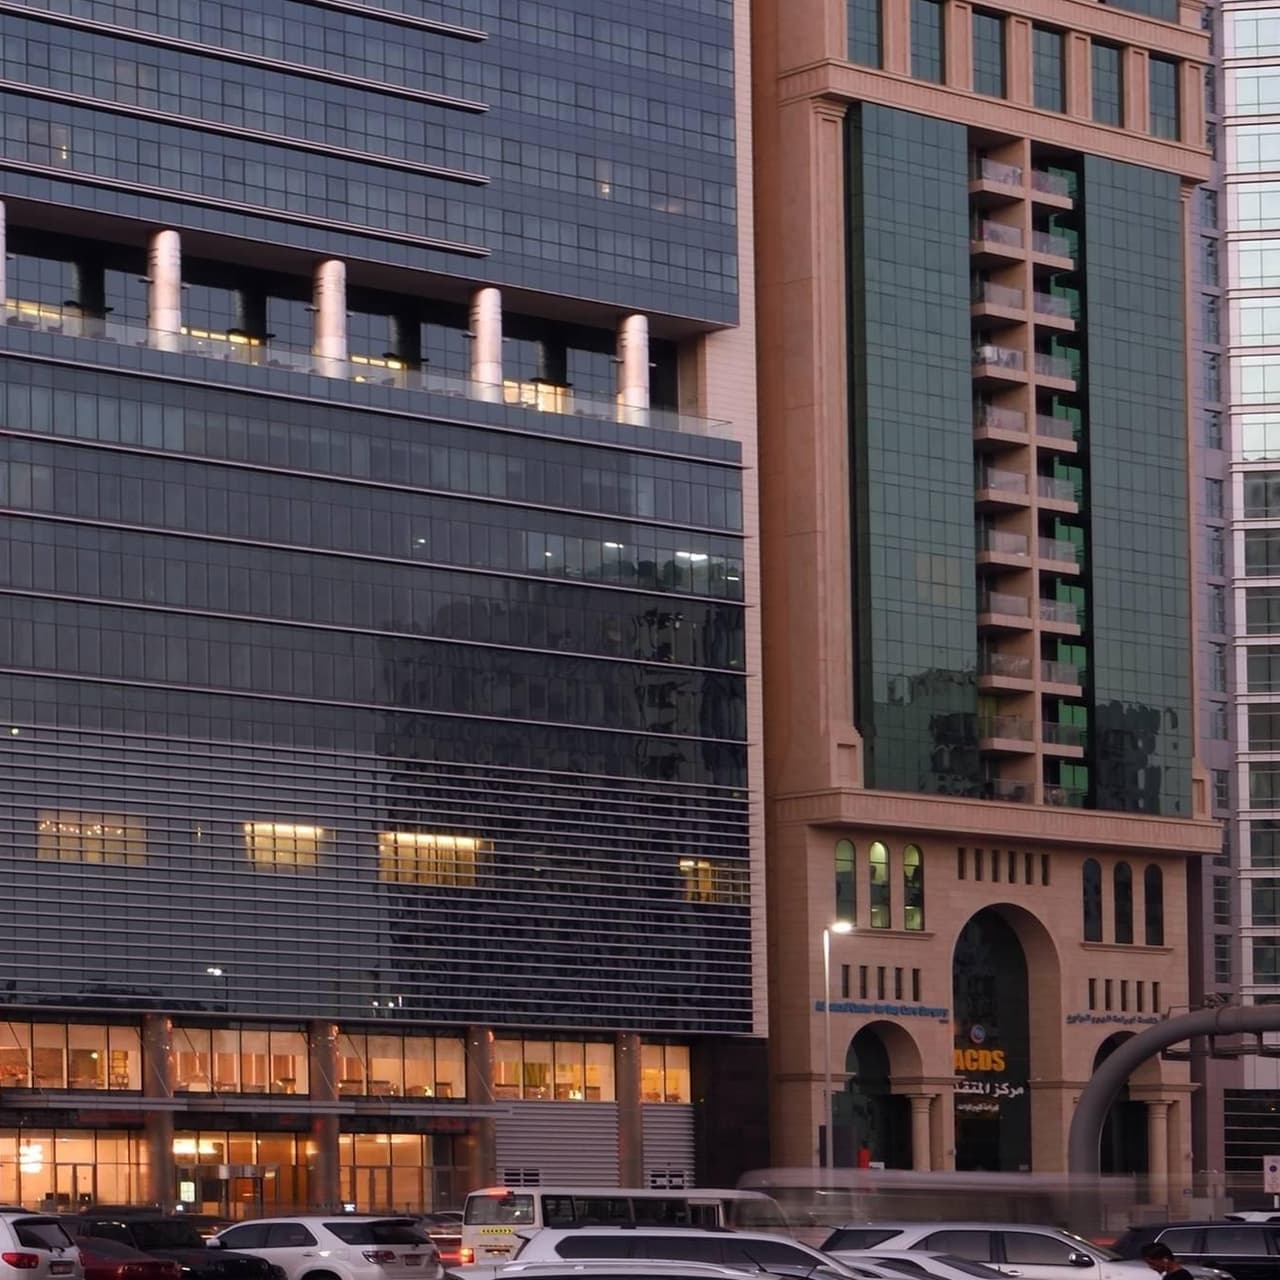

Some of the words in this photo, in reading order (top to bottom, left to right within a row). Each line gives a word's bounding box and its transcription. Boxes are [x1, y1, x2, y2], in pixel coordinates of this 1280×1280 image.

[953, 1048, 1006, 1071] ACDS
[953, 1080, 991, 1095] المتقد
[992, 1082, 1024, 1098] مركز
